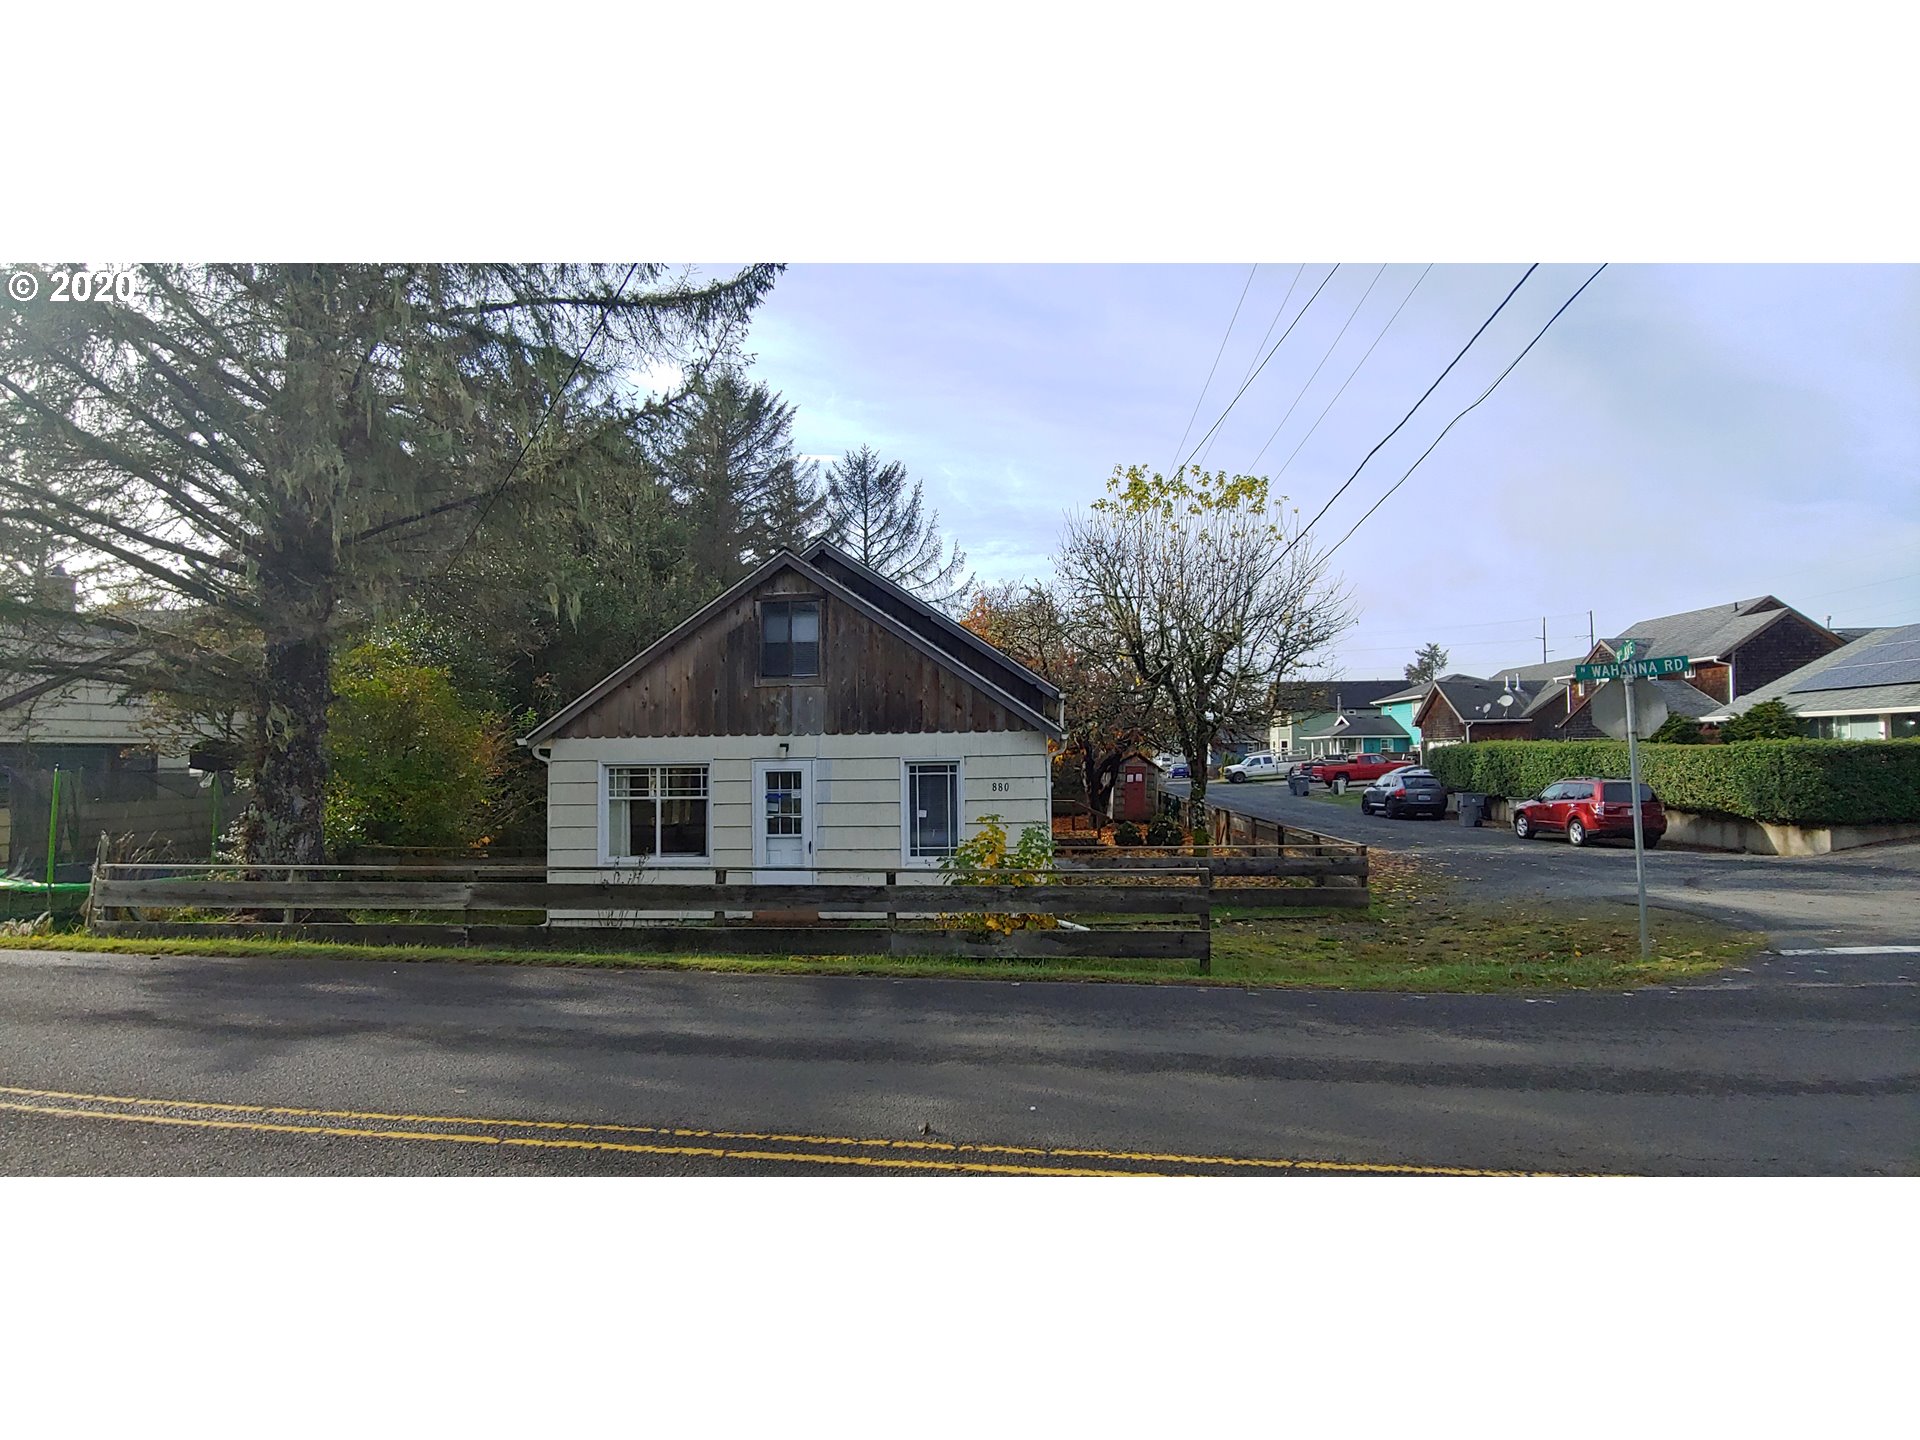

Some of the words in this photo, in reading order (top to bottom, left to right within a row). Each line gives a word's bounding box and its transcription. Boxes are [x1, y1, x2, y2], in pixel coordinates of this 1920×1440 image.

[1591, 661, 1657, 677] WAHANNA
[1664, 658, 1684, 672] RD
[992, 782, 1010, 792] 880
